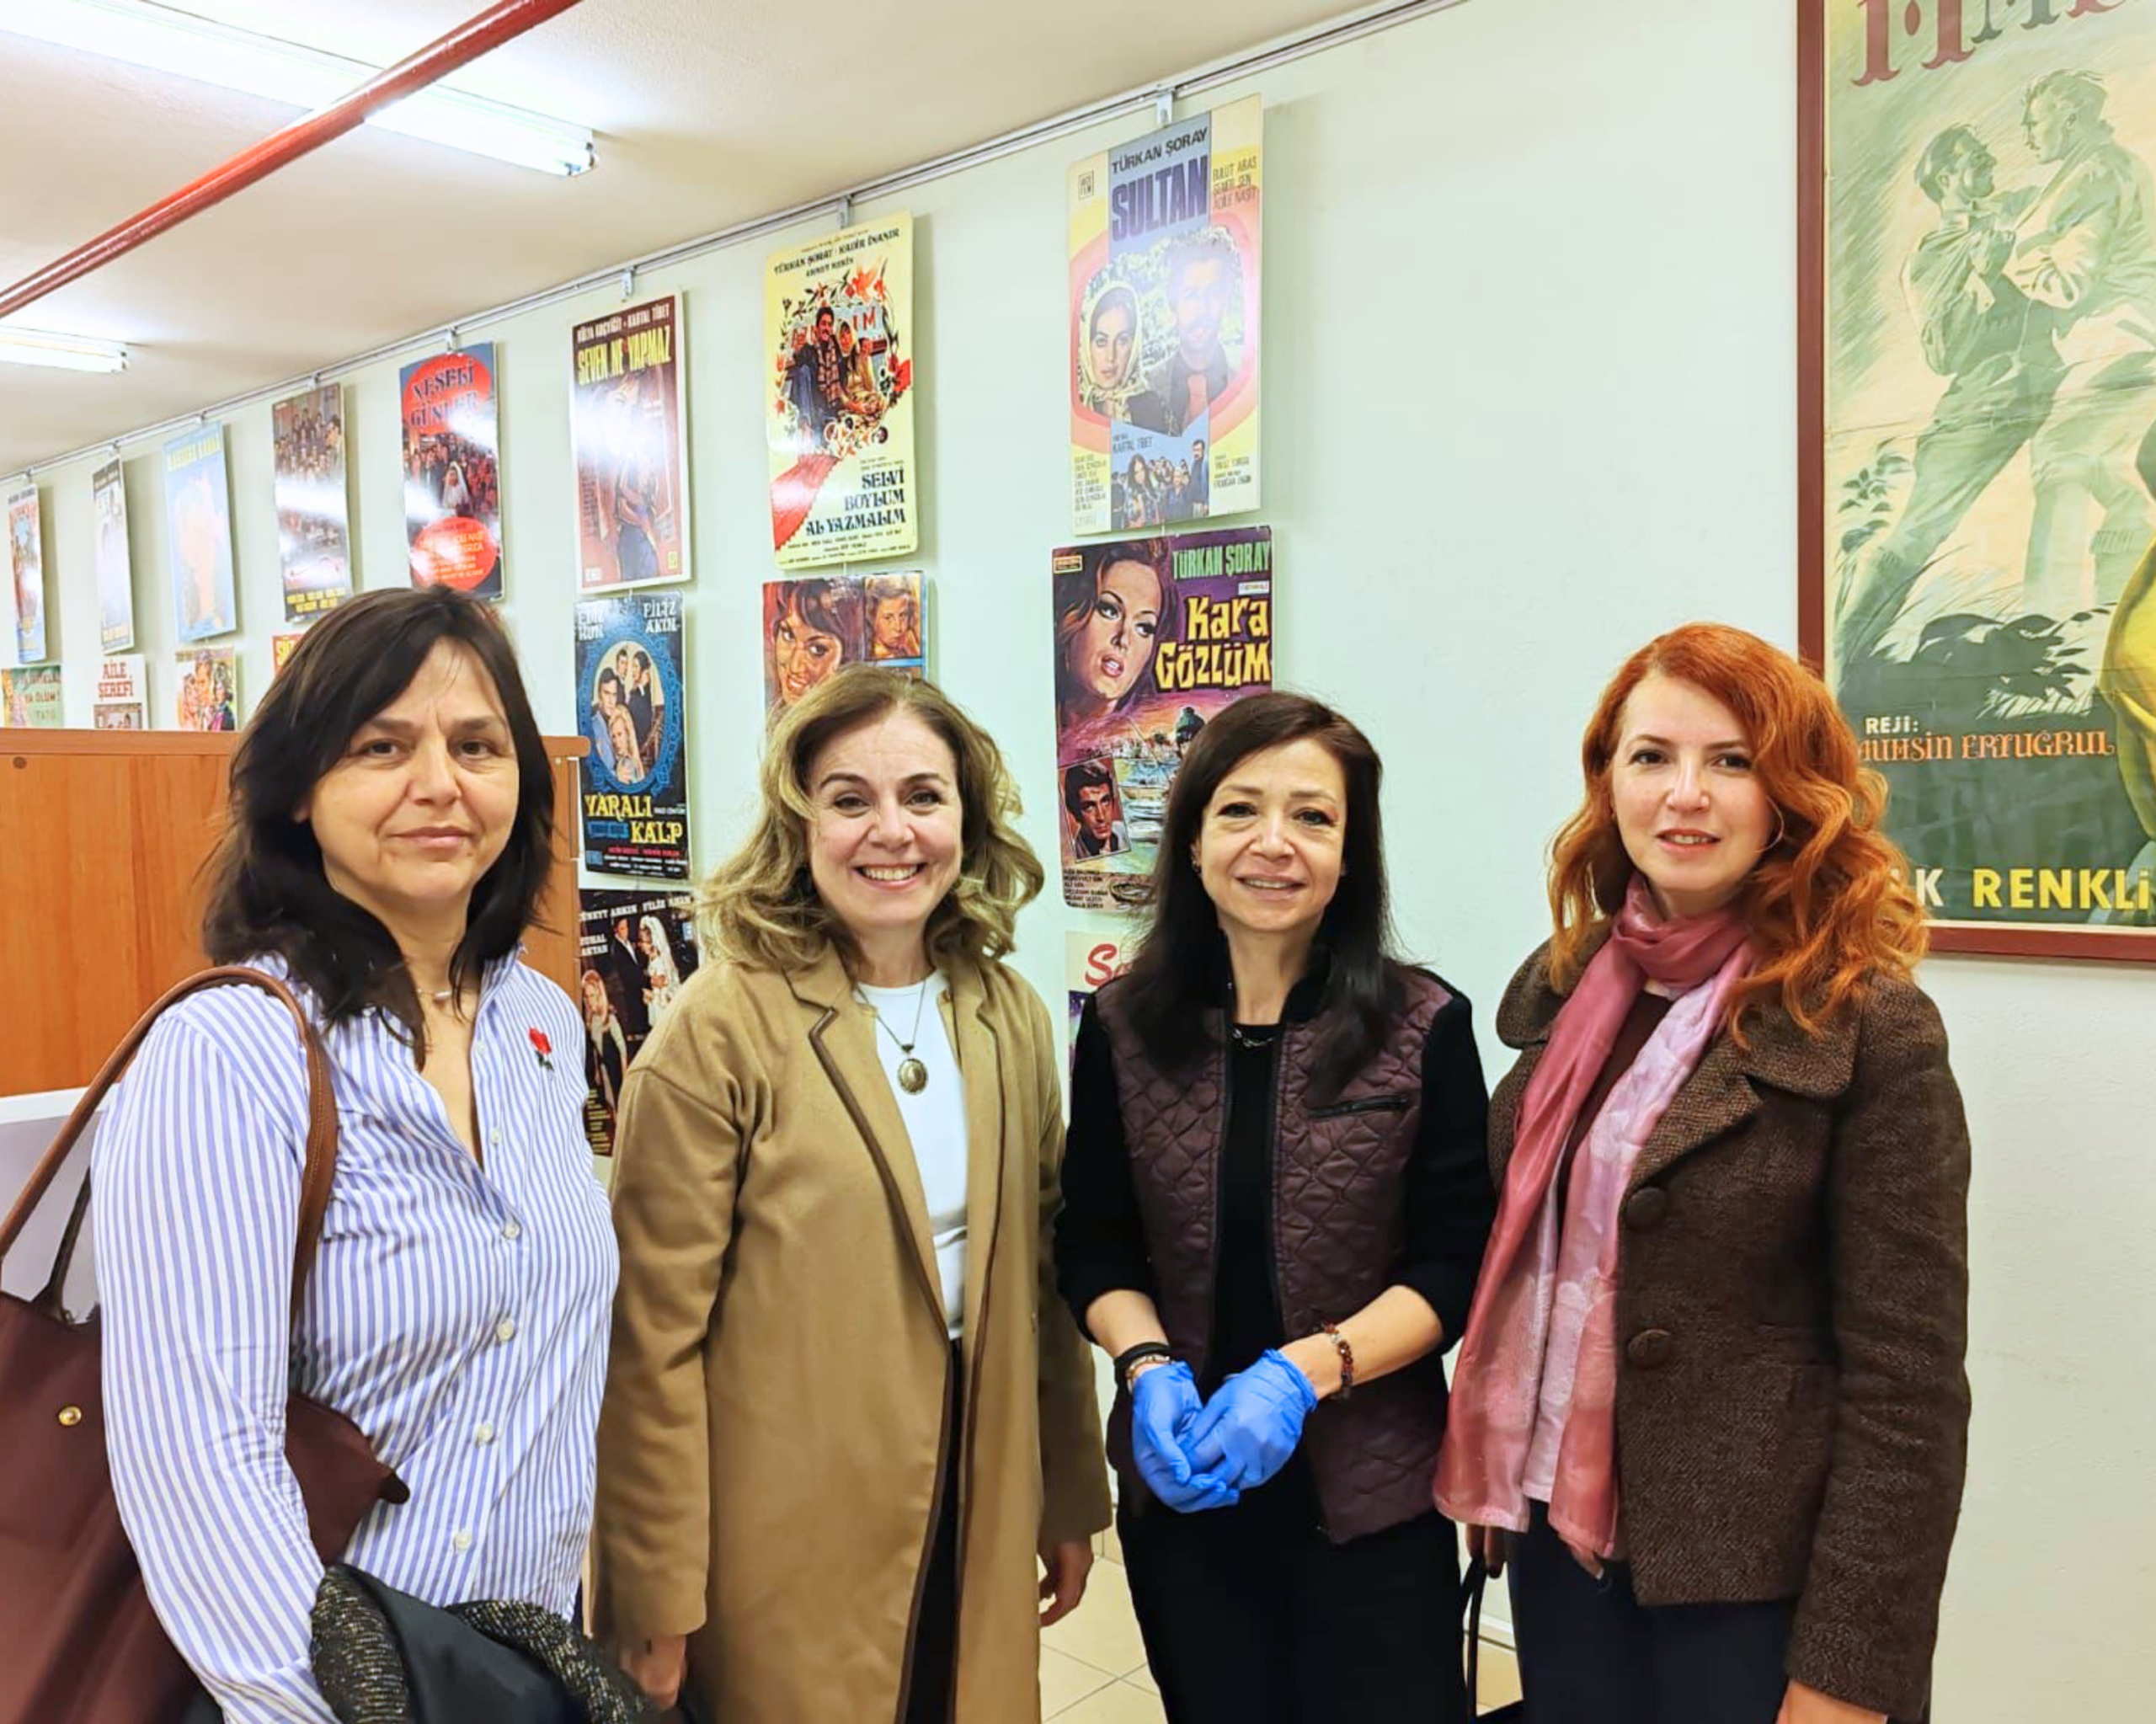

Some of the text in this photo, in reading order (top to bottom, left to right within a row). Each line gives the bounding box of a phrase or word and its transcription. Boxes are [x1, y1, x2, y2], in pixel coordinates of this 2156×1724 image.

[1112, 126, 1208, 174] TÜRKAN ŞORAY
[1112, 154, 1209, 242] SULTAN
[862, 467, 905, 490] SELVİ
[844, 488, 905, 512] BOYLUM
[805, 509, 906, 536] AL YAZMALIM
[1171, 539, 1272, 580] TÜRKAN ŞORAY
[1187, 595, 1268, 641] Kara
[1961, 729, 2116, 760] ERTUĞRUL
[584, 793, 654, 822] YARALI
[630, 820, 683, 844] KALP
